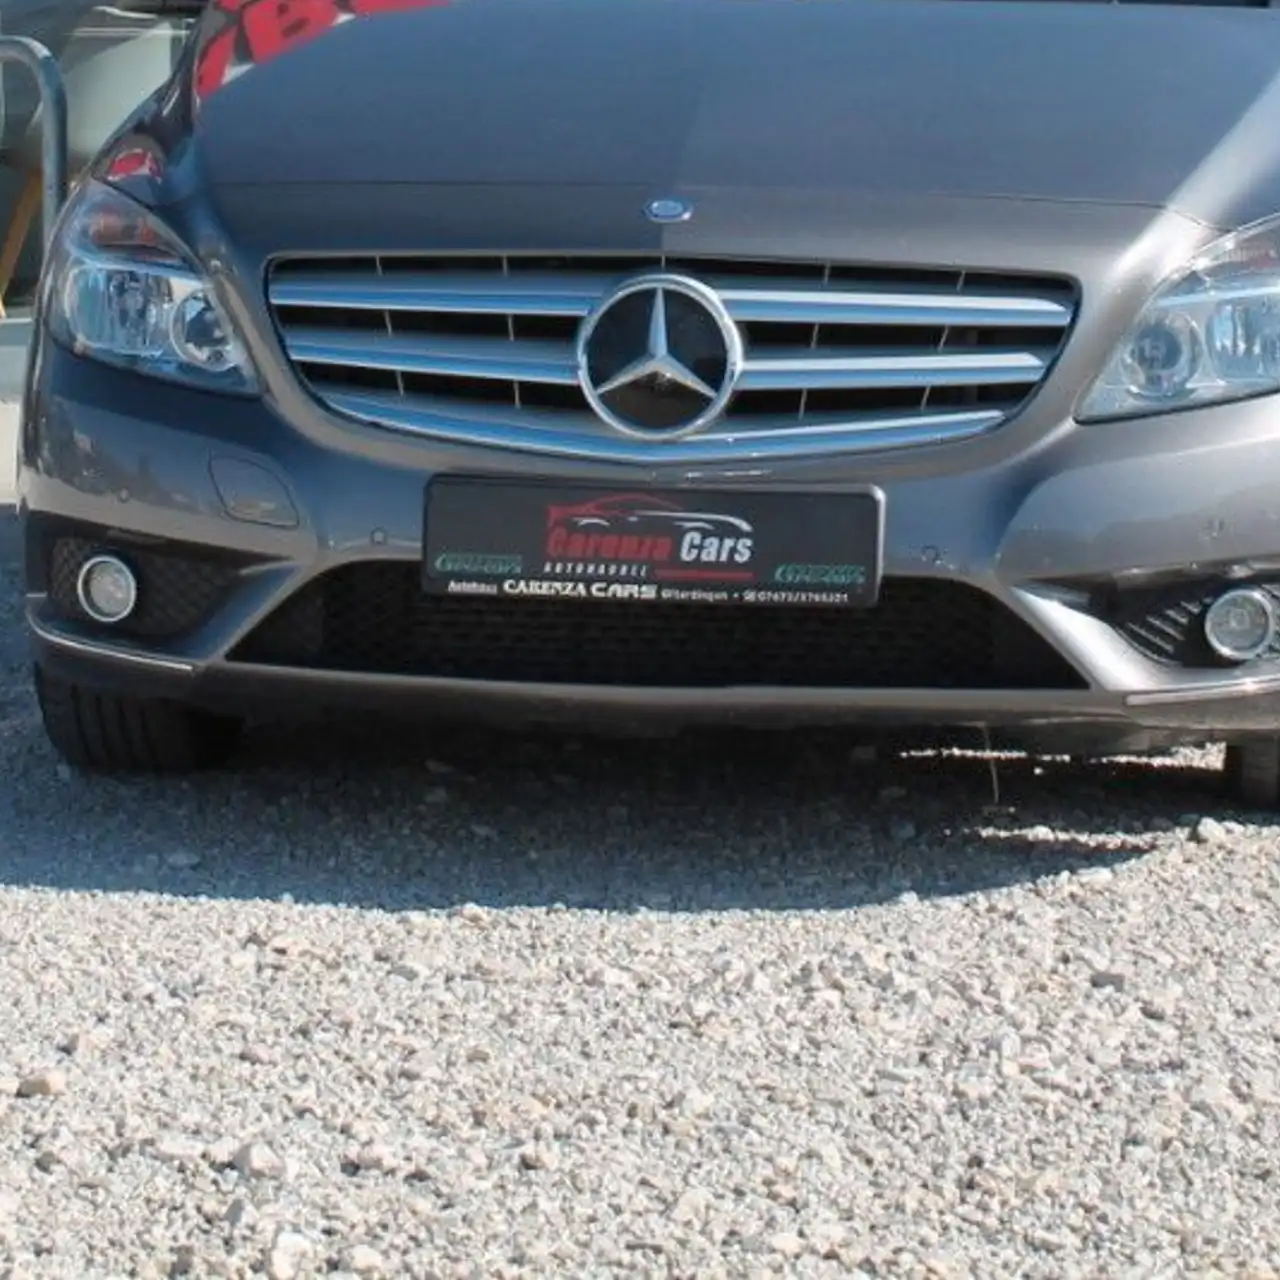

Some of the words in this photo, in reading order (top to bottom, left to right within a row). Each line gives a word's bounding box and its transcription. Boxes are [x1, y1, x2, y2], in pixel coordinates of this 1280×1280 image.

[545, 526, 674, 560] Carenza
[680, 531, 753, 563] Cars
[503, 579, 587, 597] CARENZA
[589, 582, 659, 600] CARS
